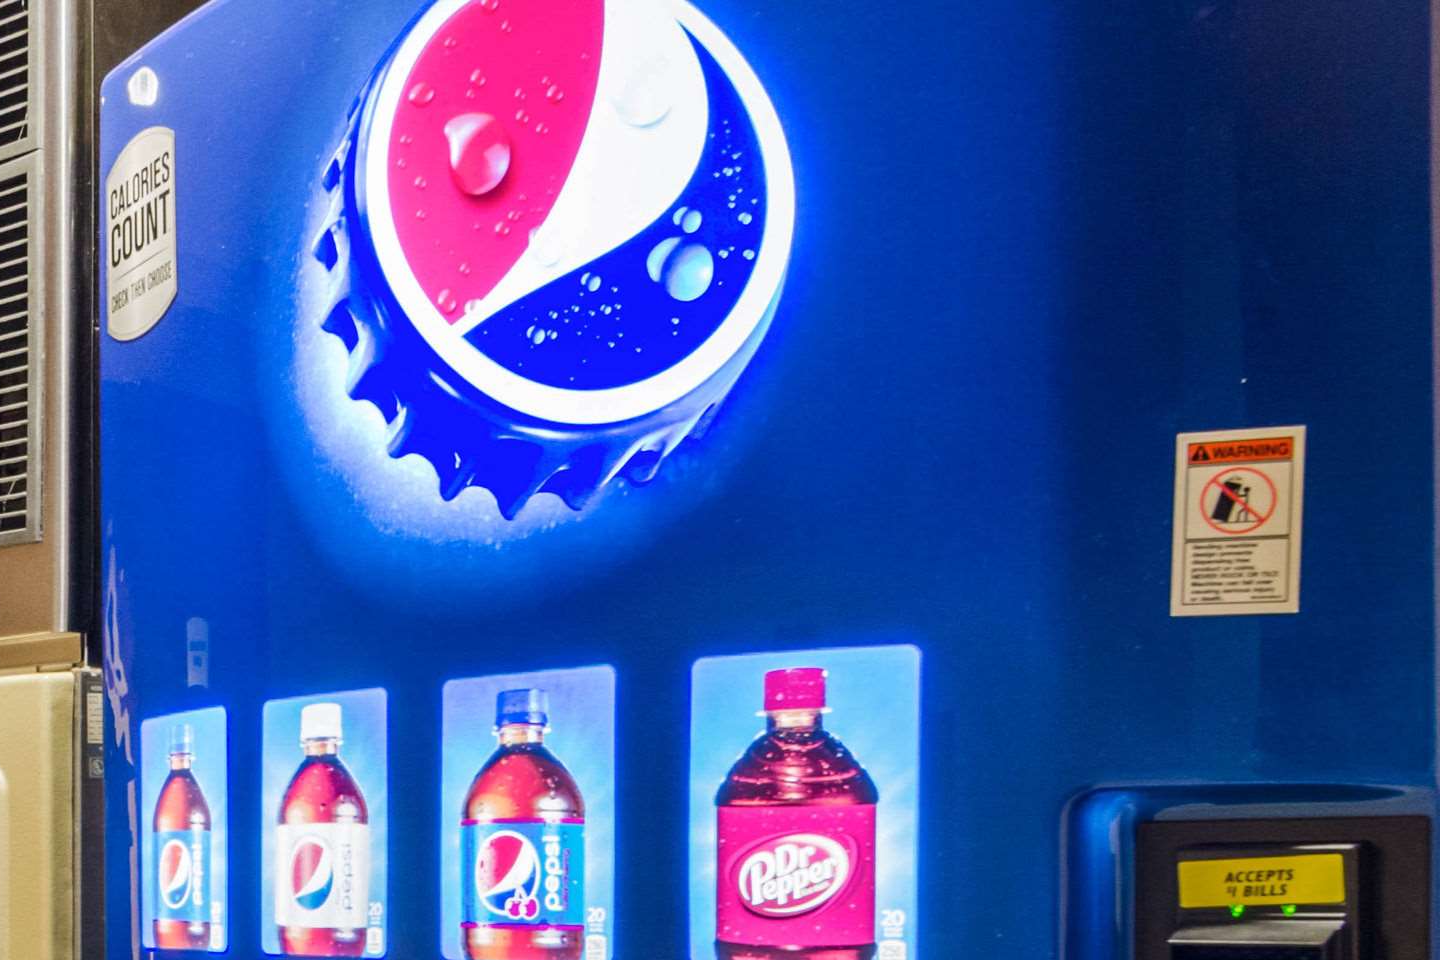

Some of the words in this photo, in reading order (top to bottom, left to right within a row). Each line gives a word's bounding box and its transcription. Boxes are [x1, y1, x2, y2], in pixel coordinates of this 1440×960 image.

[111, 152, 170, 220] CALORIES
[111, 190, 170, 268] COUNT
[131, 278, 146, 298] THEN
[147, 260, 172, 291] CHOOSE
[1213, 443, 1289, 457] WARNING
[541, 835, 564, 911] pepsi
[782, 843, 815, 870] Dr
[1224, 868, 1294, 883] ACCEPTS
[750, 850, 837, 906] Pepper
[1243, 884, 1287, 898] BILLS
